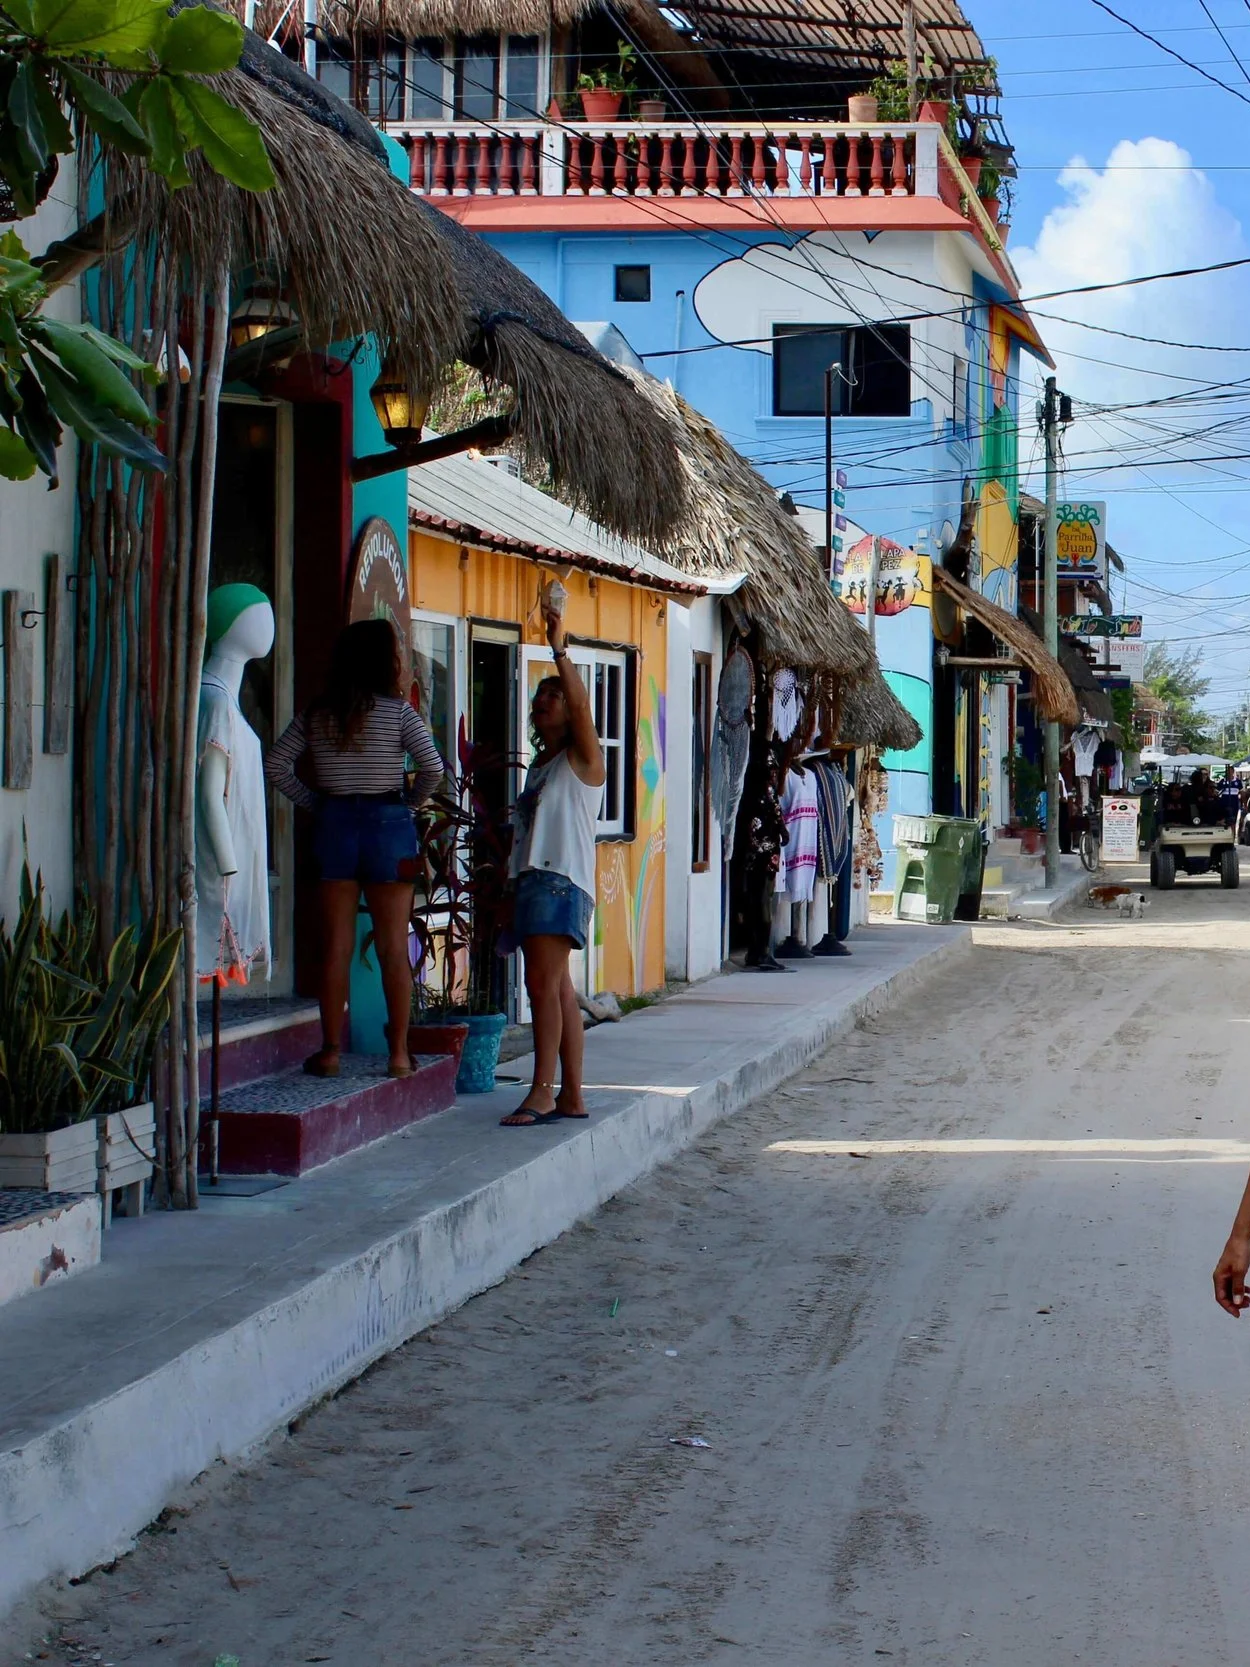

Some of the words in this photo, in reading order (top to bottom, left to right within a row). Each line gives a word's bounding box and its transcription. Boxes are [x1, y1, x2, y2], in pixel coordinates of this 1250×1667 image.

[1059, 532, 1092, 541] Parrilla
[1062, 541, 1092, 553] Juan
[848, 552, 862, 563] LA
[867, 548, 905, 561] PLAPA
[359, 531, 405, 603] REVOLUCION
[852, 563, 864, 575] DE
[1097, 644, 1140, 652] TRNSFERS
